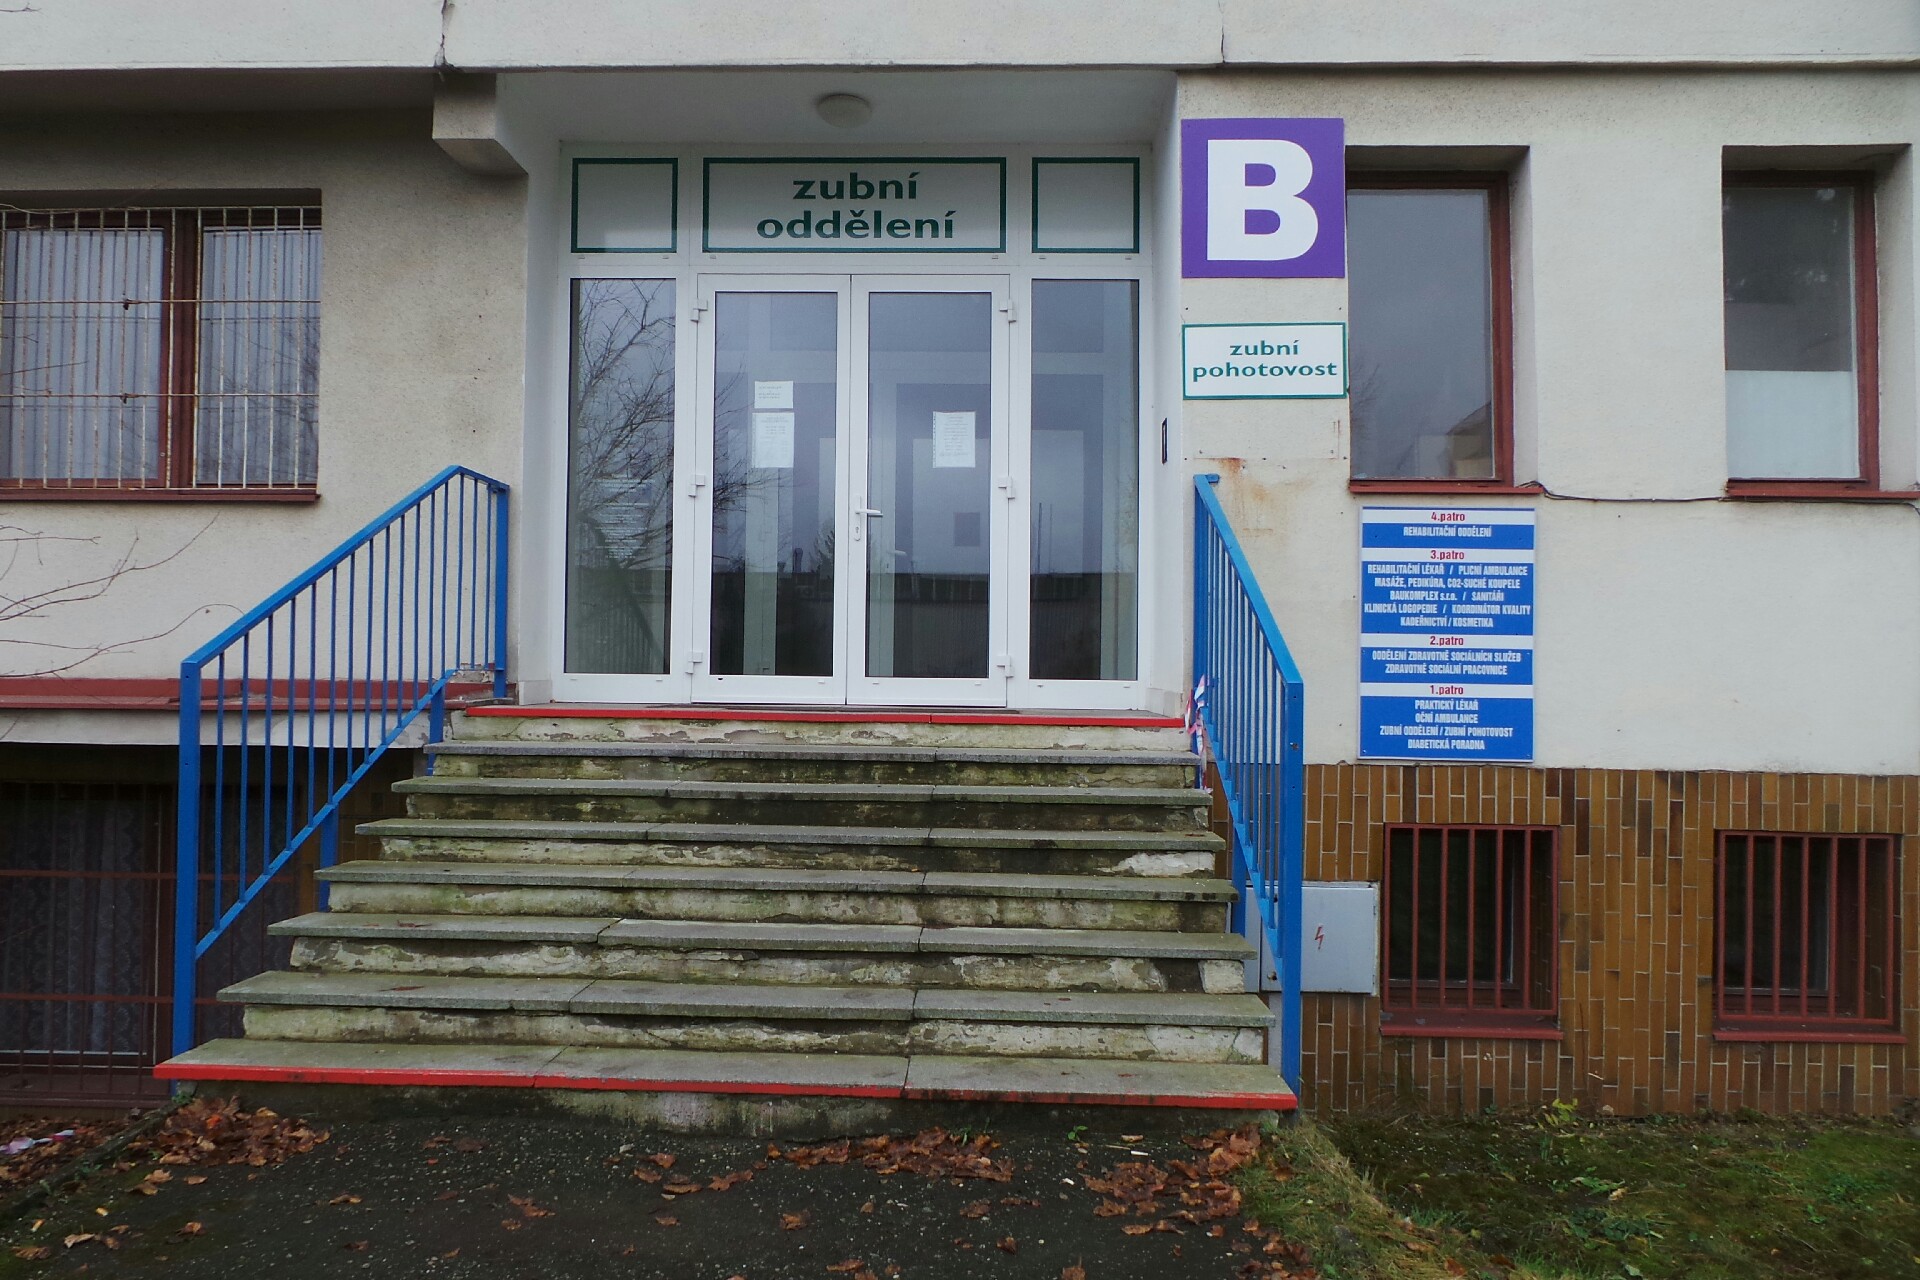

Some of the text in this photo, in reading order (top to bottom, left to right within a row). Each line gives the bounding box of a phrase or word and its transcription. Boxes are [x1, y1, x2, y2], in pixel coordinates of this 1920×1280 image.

[792, 171, 921, 201] zubní
[1207, 139, 1318, 261] B
[756, 209, 957, 240] oddělení
[1229, 339, 1299, 356] zubní
[1192, 361, 1338, 382] pohotovost
[1431, 512, 1465, 522] 4.patro
[1403, 526, 1492, 537] REHABILITAČNÍ ODDĚLENÍ
[1430, 550, 1465, 560] 3.patro
[1368, 564, 1420, 574] REHABILITAČNÍ
[1422, 564, 1444, 574] LÉKAŘ
[1459, 564, 1483, 575] PLICNÍ
[1484, 566, 1528, 575] AMBULANCE
[1488, 579, 1520, 588] KOUPELE
[1390, 592, 1439, 600] BAUKOMPLEX
[1364, 603, 1397, 613] KLINICKÁ
[1399, 604, 1437, 613] LOGOPEDIE
[1452, 603, 1500, 614] KOORDINÁTOR
[1502, 605, 1531, 615] KVALITY
[1453, 618, 1493, 628] KOSMETIKA
[1430, 636, 1464, 646] 2.patro
[1373, 650, 1407, 660] ODDĚLENÍ
[1451, 650, 1492, 662] SOCIÁLNÍCH
[1494, 651, 1521, 662] SLUŽEB
[1428, 663, 1461, 674] SOCIÁLNÍ
[1463, 665, 1507, 675] PRACOVNICE
[1430, 685, 1463, 695] 1.patro
[1415, 699, 1478, 711] PRAKTICKÝ LÉKAŘ
[1415, 713, 1478, 723] OČNÍ AMBULANCE
[1380, 724, 1402, 735] ZUBNÍ
[1404, 725, 1438, 736] ODDĚLENÍ
[1444, 725, 1466, 736] ZUBNÍ
[1468, 728, 1513, 737] POHOTOVOST
[1408, 739, 1485, 750] DIABETICKÁ PORADNA
